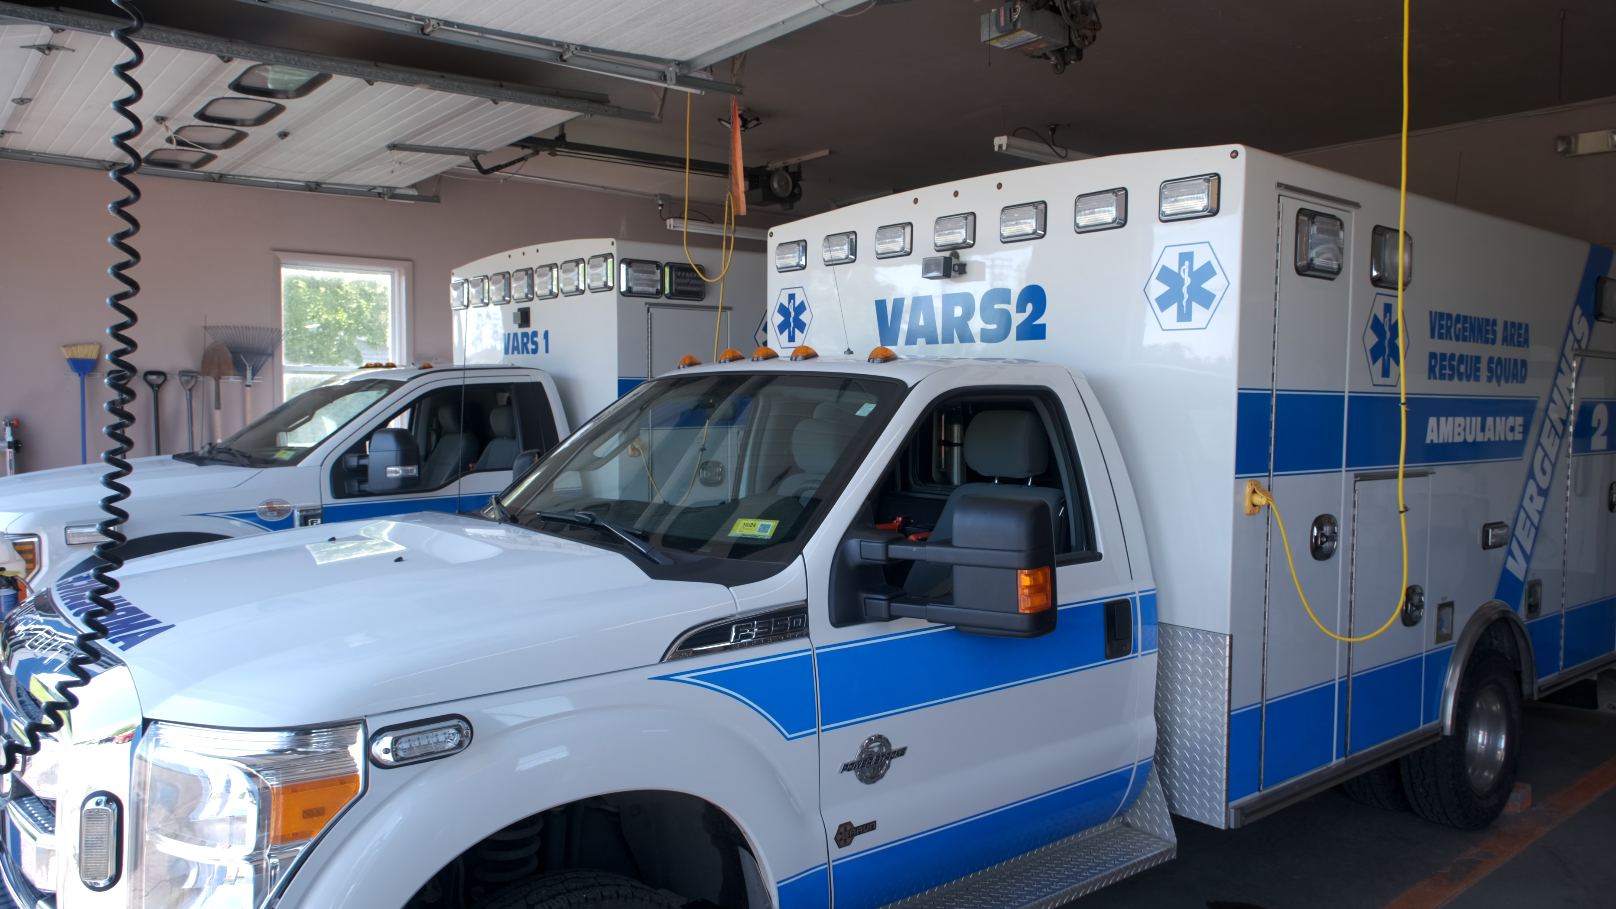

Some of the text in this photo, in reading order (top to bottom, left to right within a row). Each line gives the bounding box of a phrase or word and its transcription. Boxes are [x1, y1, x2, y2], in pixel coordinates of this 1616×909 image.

[503, 329, 550, 355] VARS 1
[1429, 310, 1530, 348] VERGENNES AREA
[1427, 351, 1528, 388] RESCUE SQUAD
[1425, 416, 1524, 444] AMBULANCE
[1505, 304, 1590, 582] VERGENNES
[1590, 403, 1609, 451] 2
